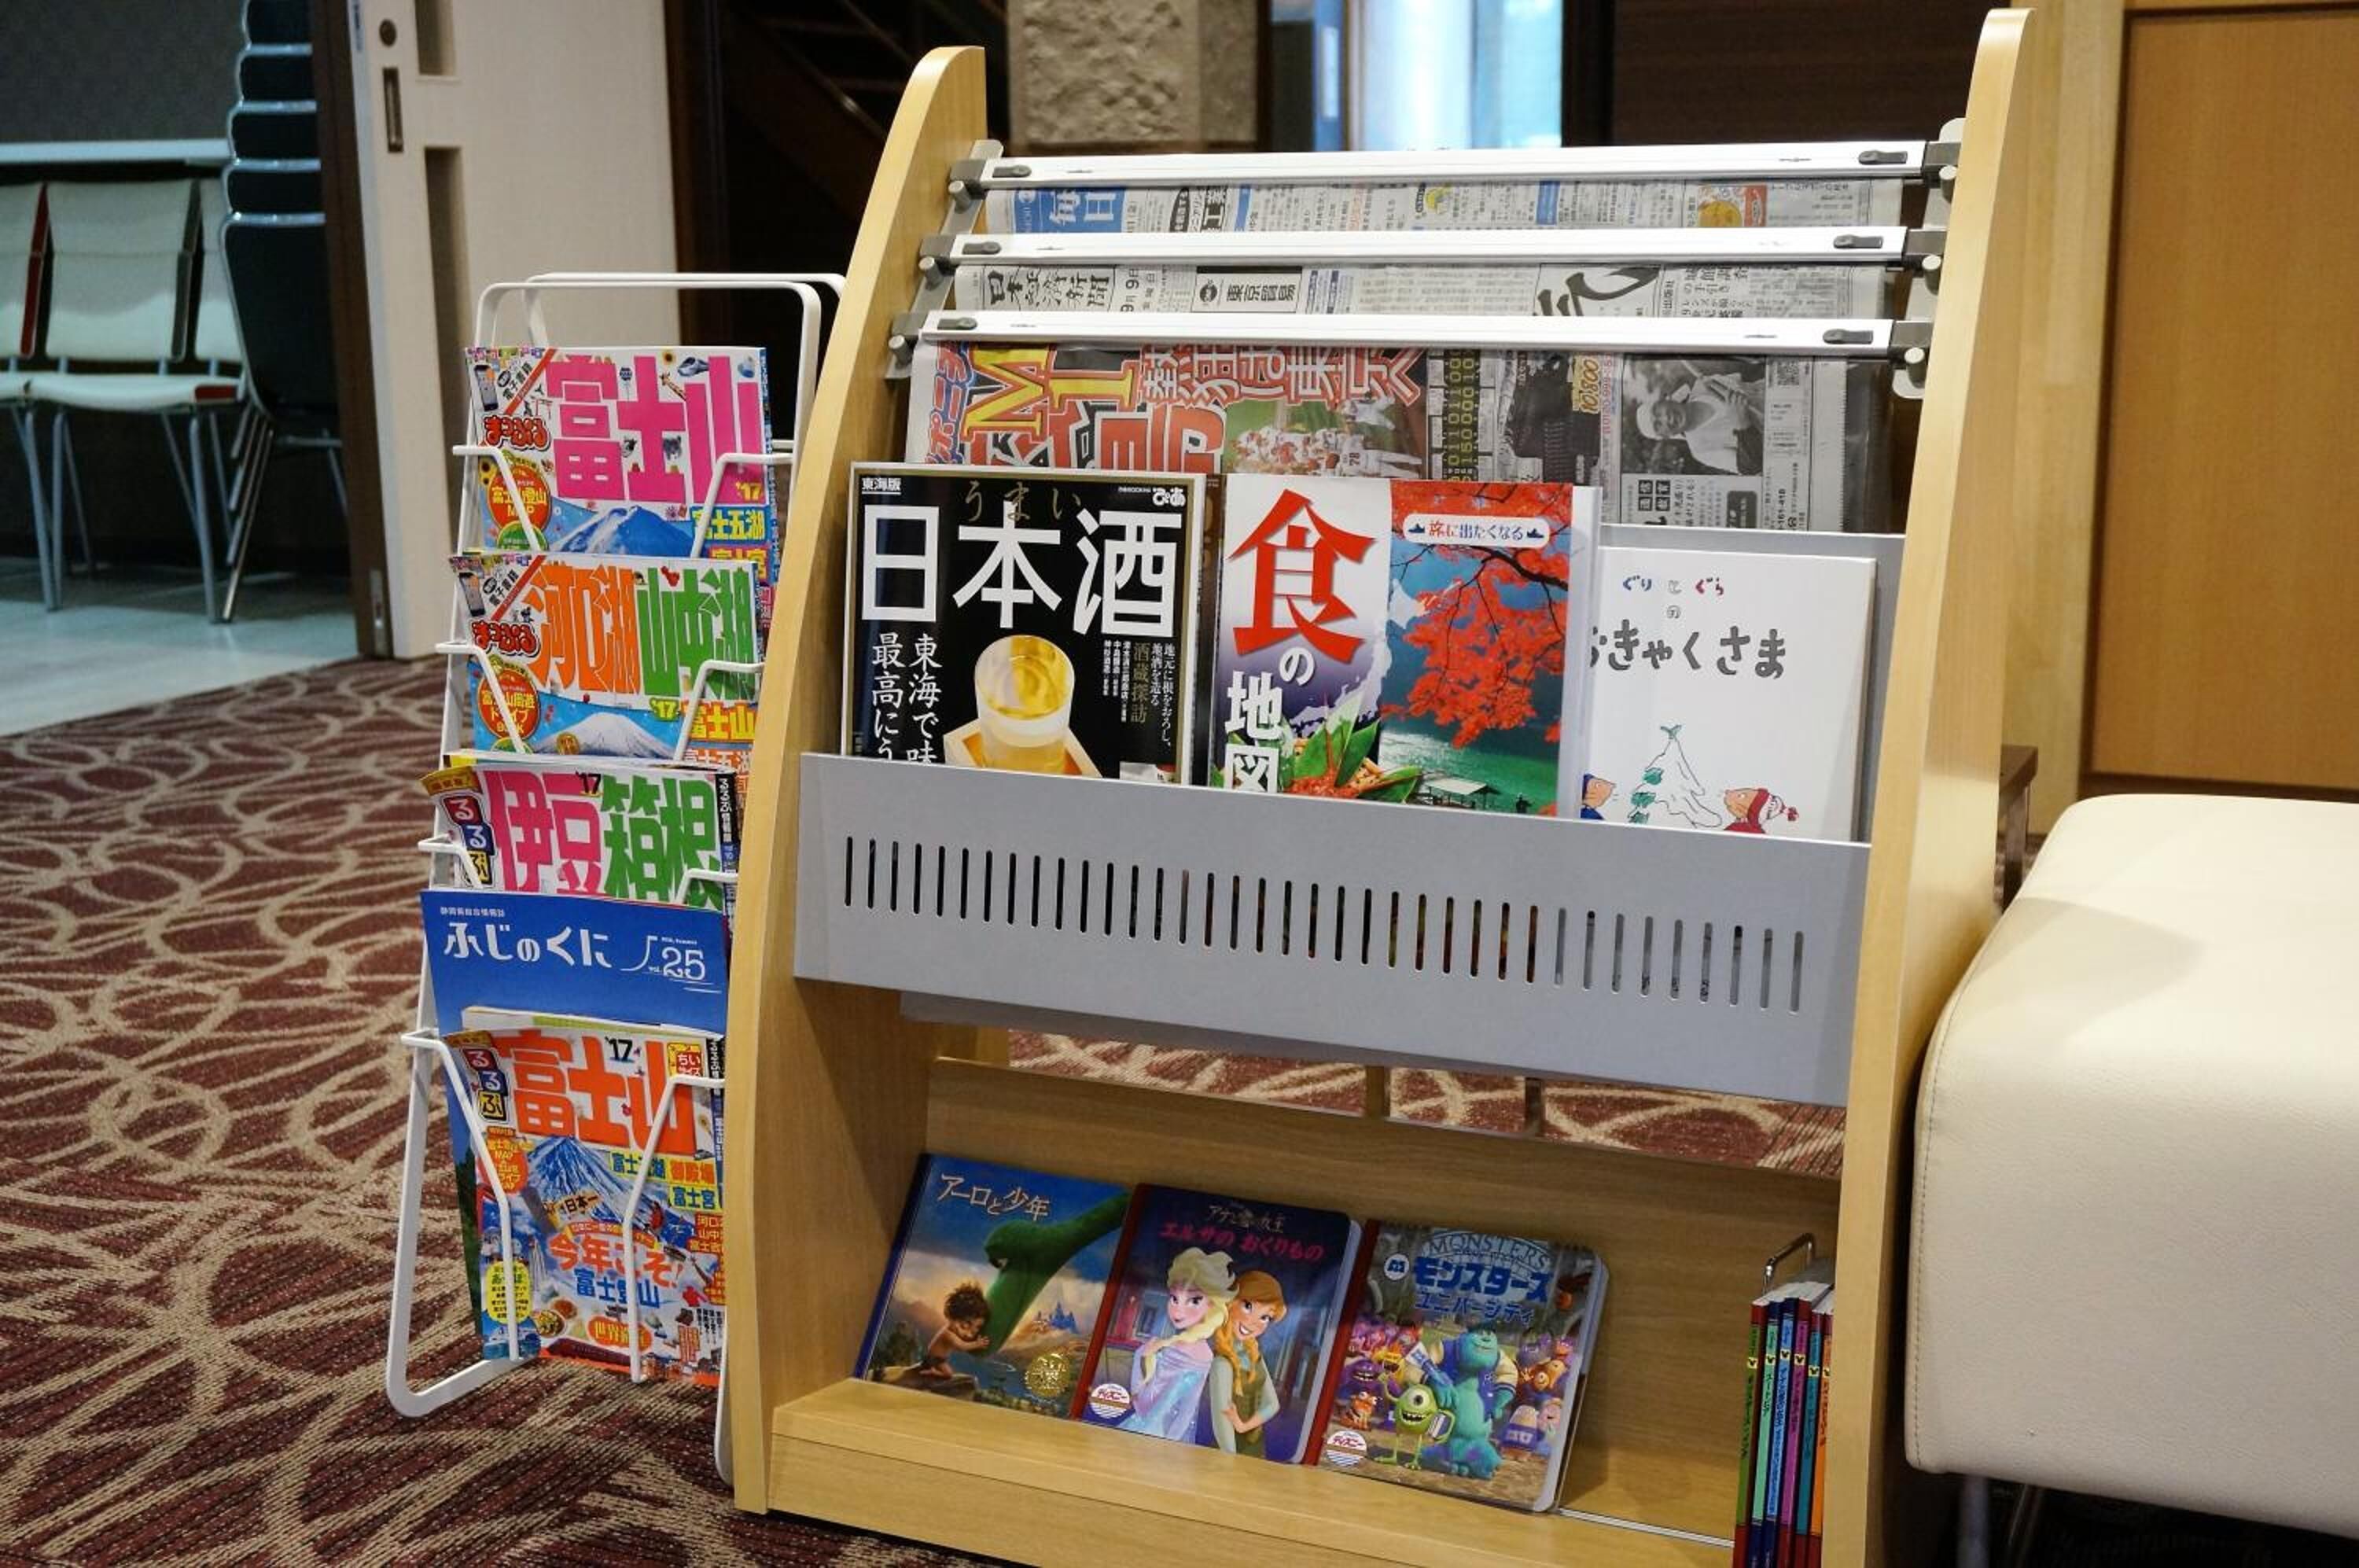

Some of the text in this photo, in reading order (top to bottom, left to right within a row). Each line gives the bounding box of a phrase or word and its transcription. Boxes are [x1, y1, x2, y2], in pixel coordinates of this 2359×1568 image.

[988, 269, 1110, 307] 日本経済新聞
[546, 355, 767, 504] 富士山
[491, 486, 547, 505] 富士登山
[862, 477, 901, 491] 東海版
[964, 480, 1082, 524] うまい
[1152, 487, 1187, 507] ぴあ
[507, 503, 535, 516] MP
[1428, 520, 1525, 542] 旅に出たくなる
[862, 500, 1183, 638] 日本酒
[522, 563, 756, 701] 河口湖 山中湖
[871, 631, 906, 761] 最高にう
[906, 631, 943, 764] 東海で味
[443, 922, 613, 968] ふじのくに
[661, 946, 705, 981] 25
[492, 1029, 697, 1155] 富士山
[612, 1153, 666, 1180] 富士湖
[672, 1186, 715, 1210] 富士宮
[937, 1173, 1051, 1221] アーロと少年
